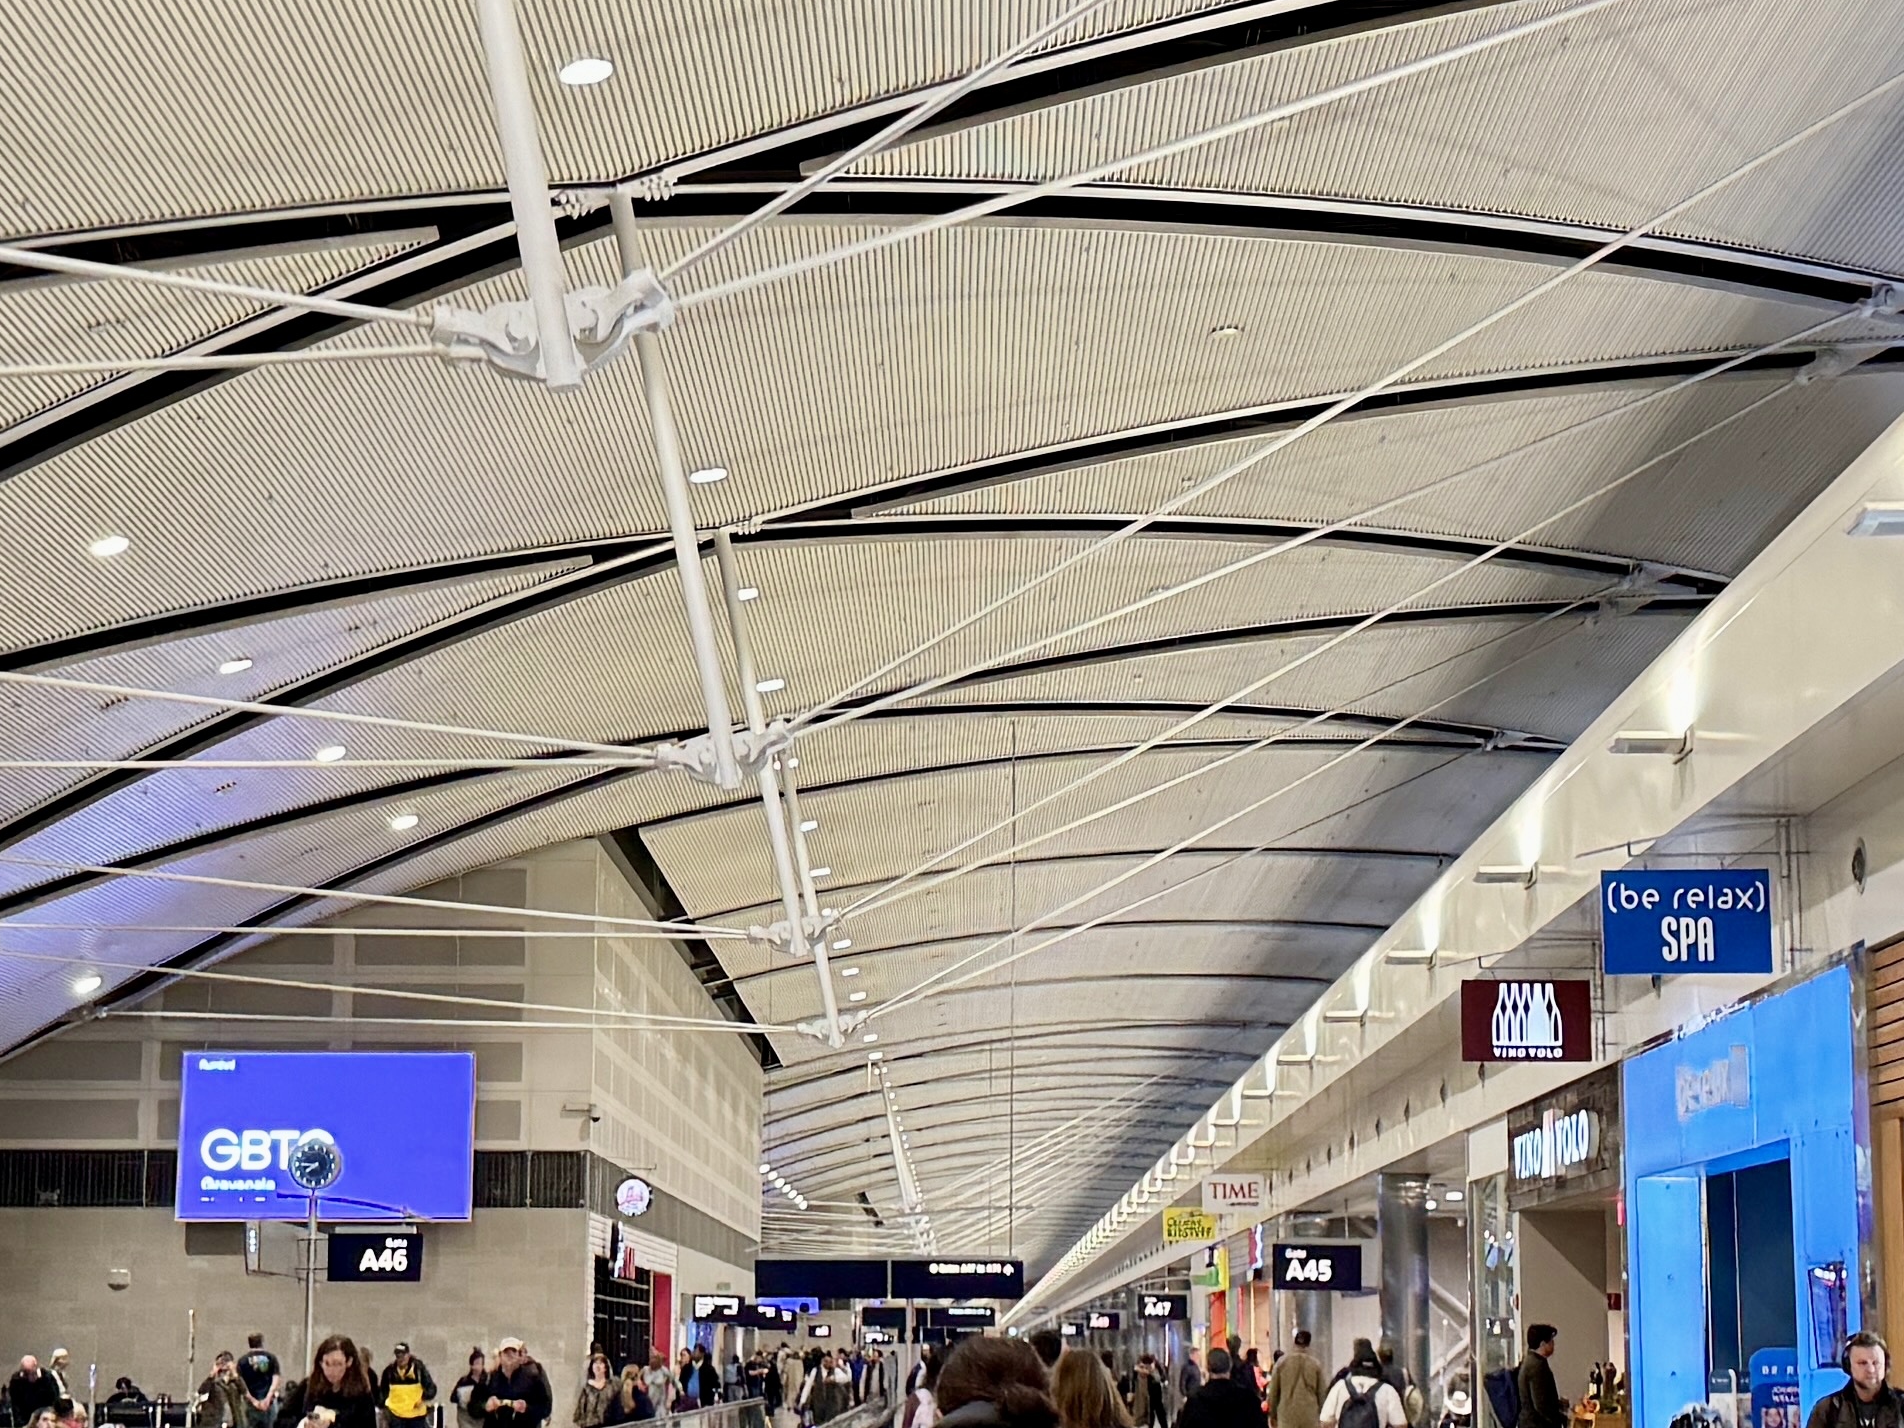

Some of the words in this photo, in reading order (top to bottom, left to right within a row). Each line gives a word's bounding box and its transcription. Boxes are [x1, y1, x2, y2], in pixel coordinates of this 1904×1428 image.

[1661, 916, 1715, 962] SPA
[1493, 1047, 1526, 1058] VINO
[1528, 1047, 1563, 1058] VOLO
[1208, 1181, 1259, 1200] TIME
[359, 1248, 408, 1272] A46
[1285, 1259, 1333, 1283] A45
